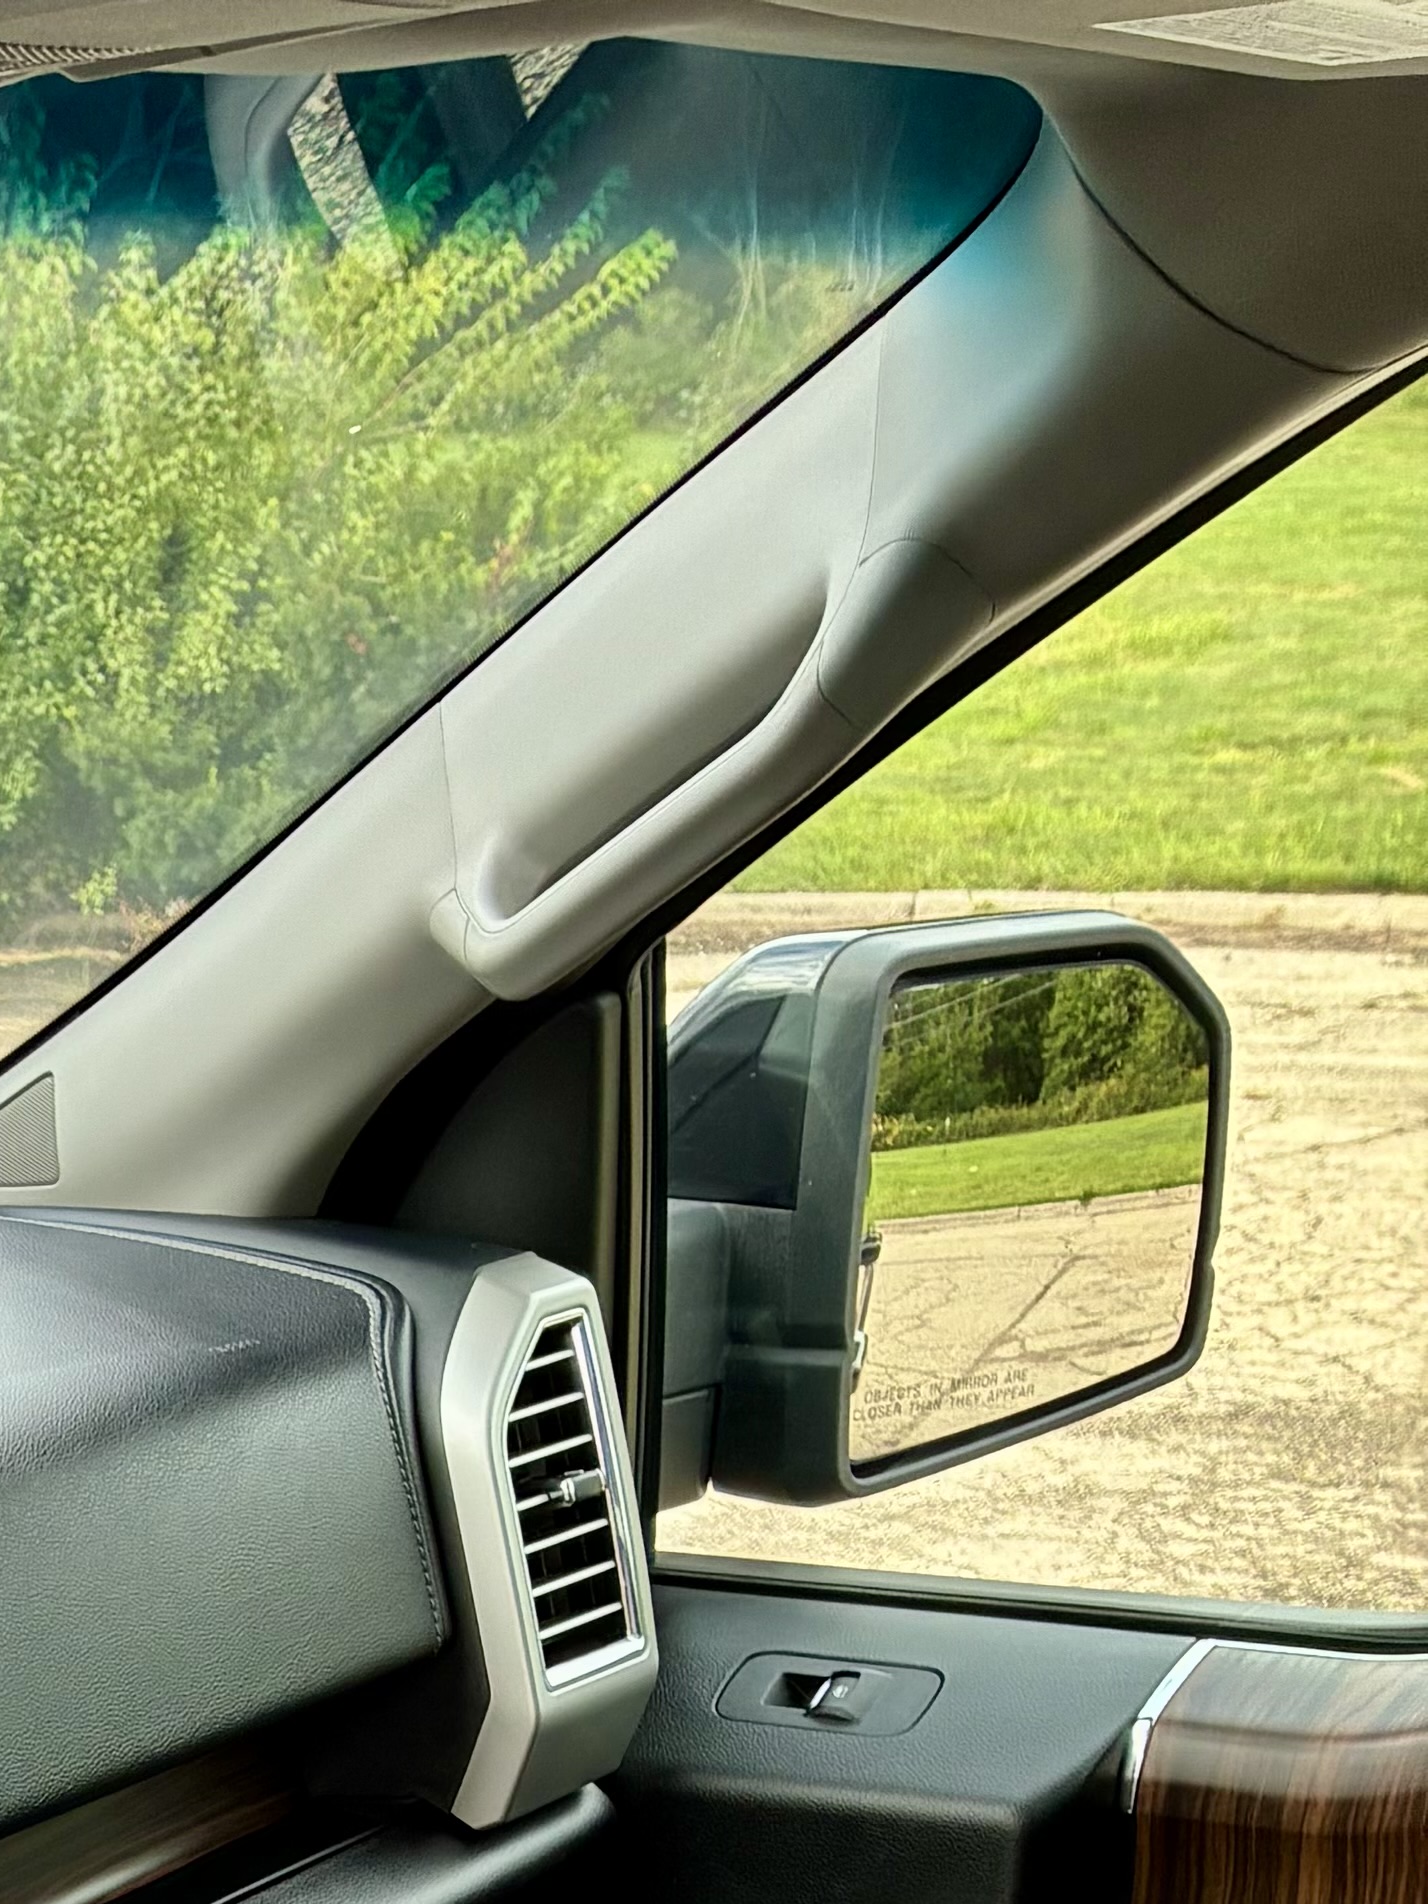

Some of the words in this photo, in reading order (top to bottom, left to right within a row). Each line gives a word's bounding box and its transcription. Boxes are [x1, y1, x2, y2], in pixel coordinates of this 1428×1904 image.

[853, 1402, 902, 1421] CLOSER
[909, 1400, 942, 1414] THAN
[950, 1394, 981, 1409] THEY
[987, 1384, 1035, 1403] APPEAR
[864, 1385, 921, 1404] OBJECTS
[929, 1380, 943, 1395] IN
[950, 1375, 997, 1393] MIRROR
[1004, 1368, 1028, 1385] ARE
